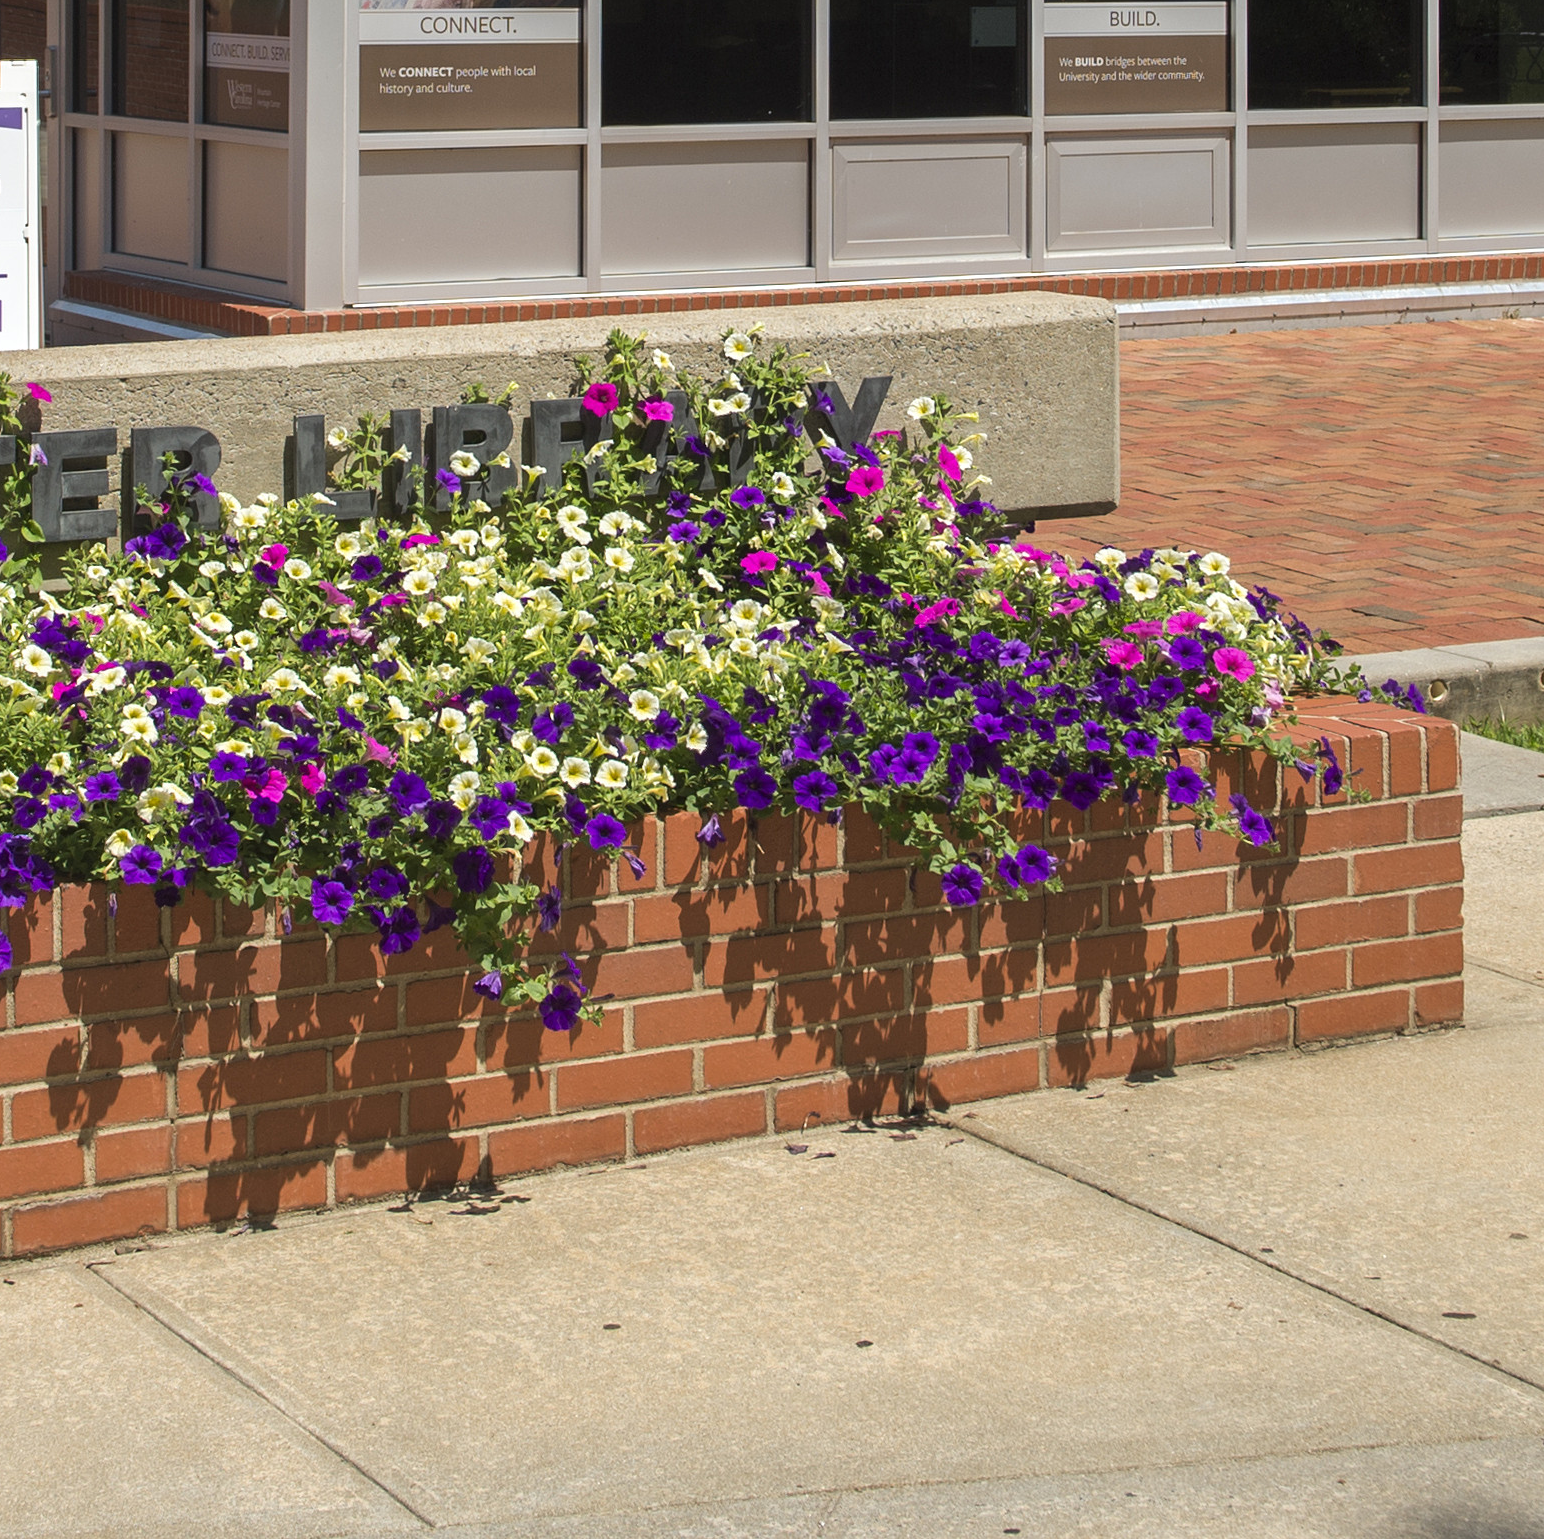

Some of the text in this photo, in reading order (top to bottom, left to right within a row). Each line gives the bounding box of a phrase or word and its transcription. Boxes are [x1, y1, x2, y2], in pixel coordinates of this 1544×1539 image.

[420, 16, 517, 34] CONNECT.
[1110, 11, 1160, 27] BUILD.
[1059, 55, 1188, 69] We BUILD bridges between the
[379, 65, 536, 79] We CONNECT people with local
[1059, 70, 1205, 84] University and the wider community.
[379, 82, 473, 96] history and culture.
